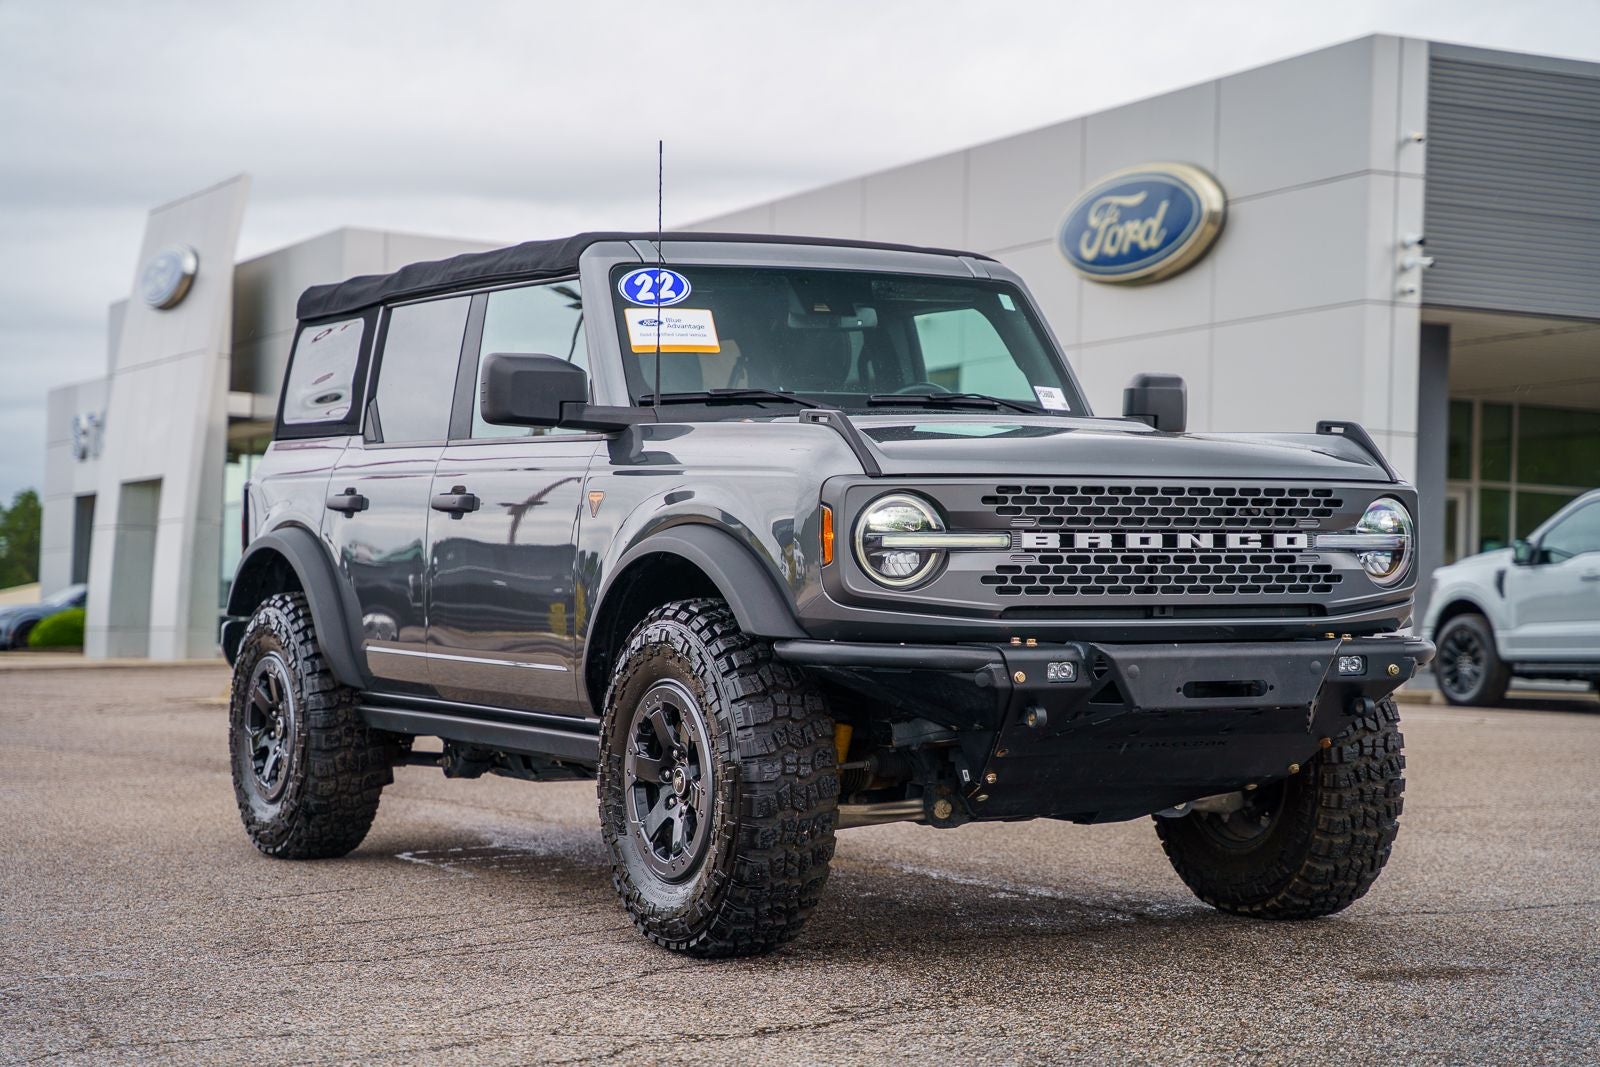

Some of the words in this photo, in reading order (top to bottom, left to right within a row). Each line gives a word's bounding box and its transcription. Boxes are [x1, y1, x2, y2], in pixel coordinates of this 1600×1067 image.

[1080, 190, 1169, 261] Ford
[634, 272, 676, 301] 22
[1021, 532, 1308, 549] BRONCO
